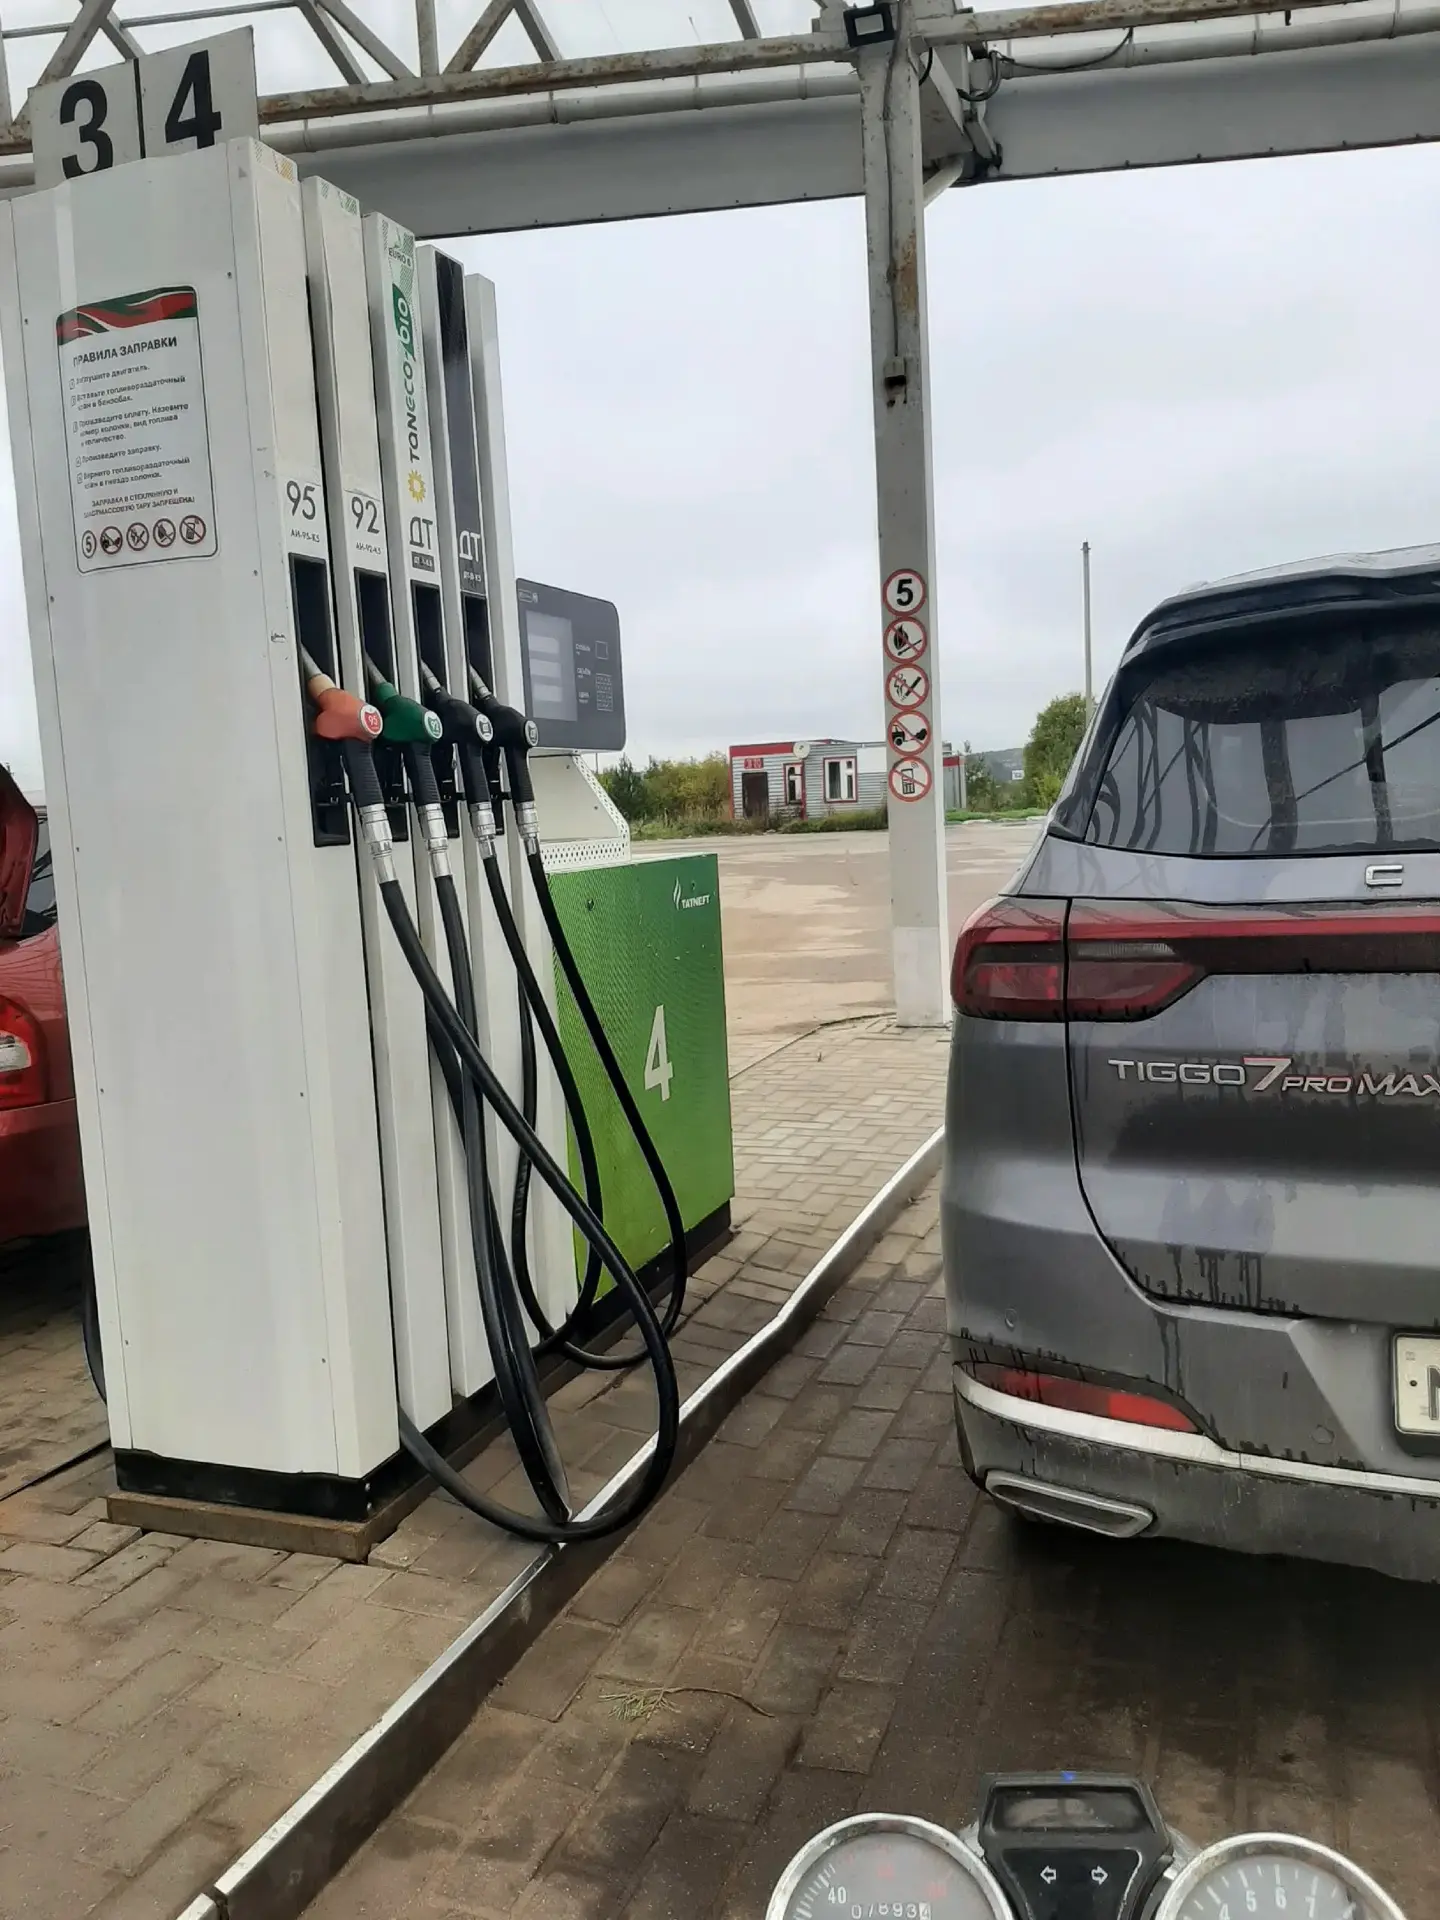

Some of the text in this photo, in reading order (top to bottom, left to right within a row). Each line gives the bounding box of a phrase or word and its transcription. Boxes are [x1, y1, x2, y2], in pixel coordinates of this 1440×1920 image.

[165, 50, 222, 149] 4
[60, 79, 113, 179] 3
[73, 336, 178, 367] ПРАВИЛА ЗАПРАВКИ
[107, 374, 186, 396] топливораздаточный
[133, 419, 148, 428] вид
[148, 414, 179, 424] топлива
[152, 403, 189, 414] Назовите
[111, 456, 191, 475] топливораздаточный
[286, 480, 316, 521] 95
[352, 496, 380, 534] 92
[85, 536, 93, 553] 5
[409, 516, 434, 550] ДТ
[459, 530, 482, 562] ДТ
[896, 577, 914, 607] 5
[681, 894, 711, 909] TATNEFT
[644, 1003, 674, 1102] 4
[1107, 1058, 1246, 1086] TIGGO
[1281, 1075, 1352, 1094] PRO
[1357, 1071, 1440, 1097] MAX
[827, 1885, 848, 1905] 40
[1244, 1889, 1258, 1913] 5
[1275, 1886, 1288, 1910] 6
[1305, 1895, 1317, 1919] 7
